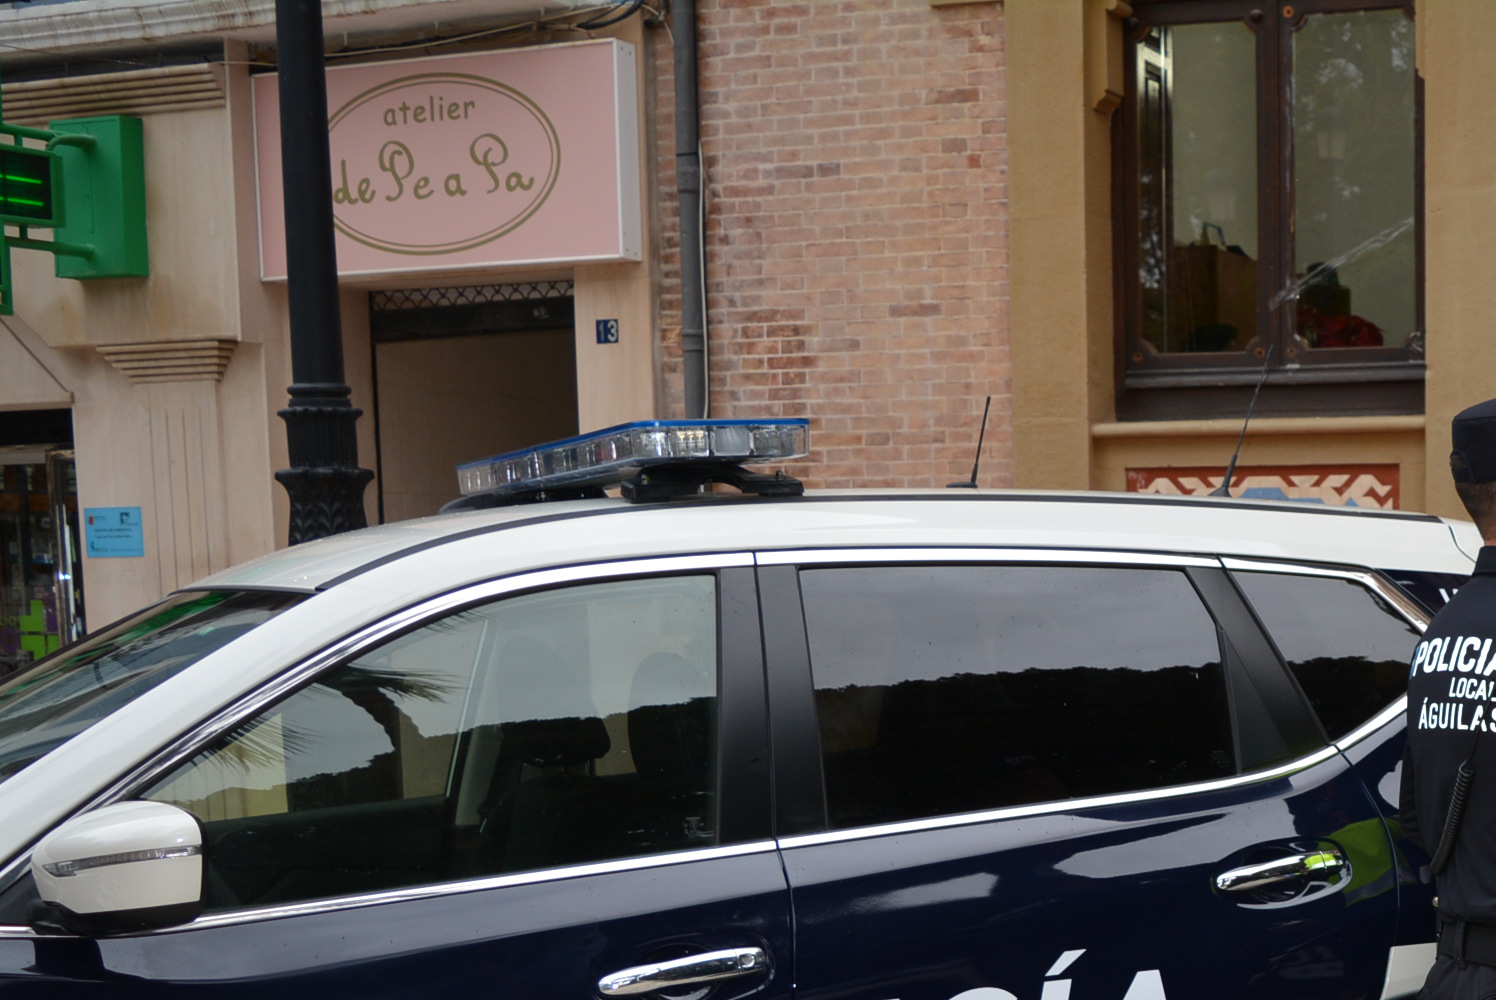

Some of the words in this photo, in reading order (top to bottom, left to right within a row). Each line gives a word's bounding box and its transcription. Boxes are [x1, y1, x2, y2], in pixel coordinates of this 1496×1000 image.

[383, 95, 475, 126] atelier
[334, 158, 376, 205] de
[599, 320, 617, 342] 13
